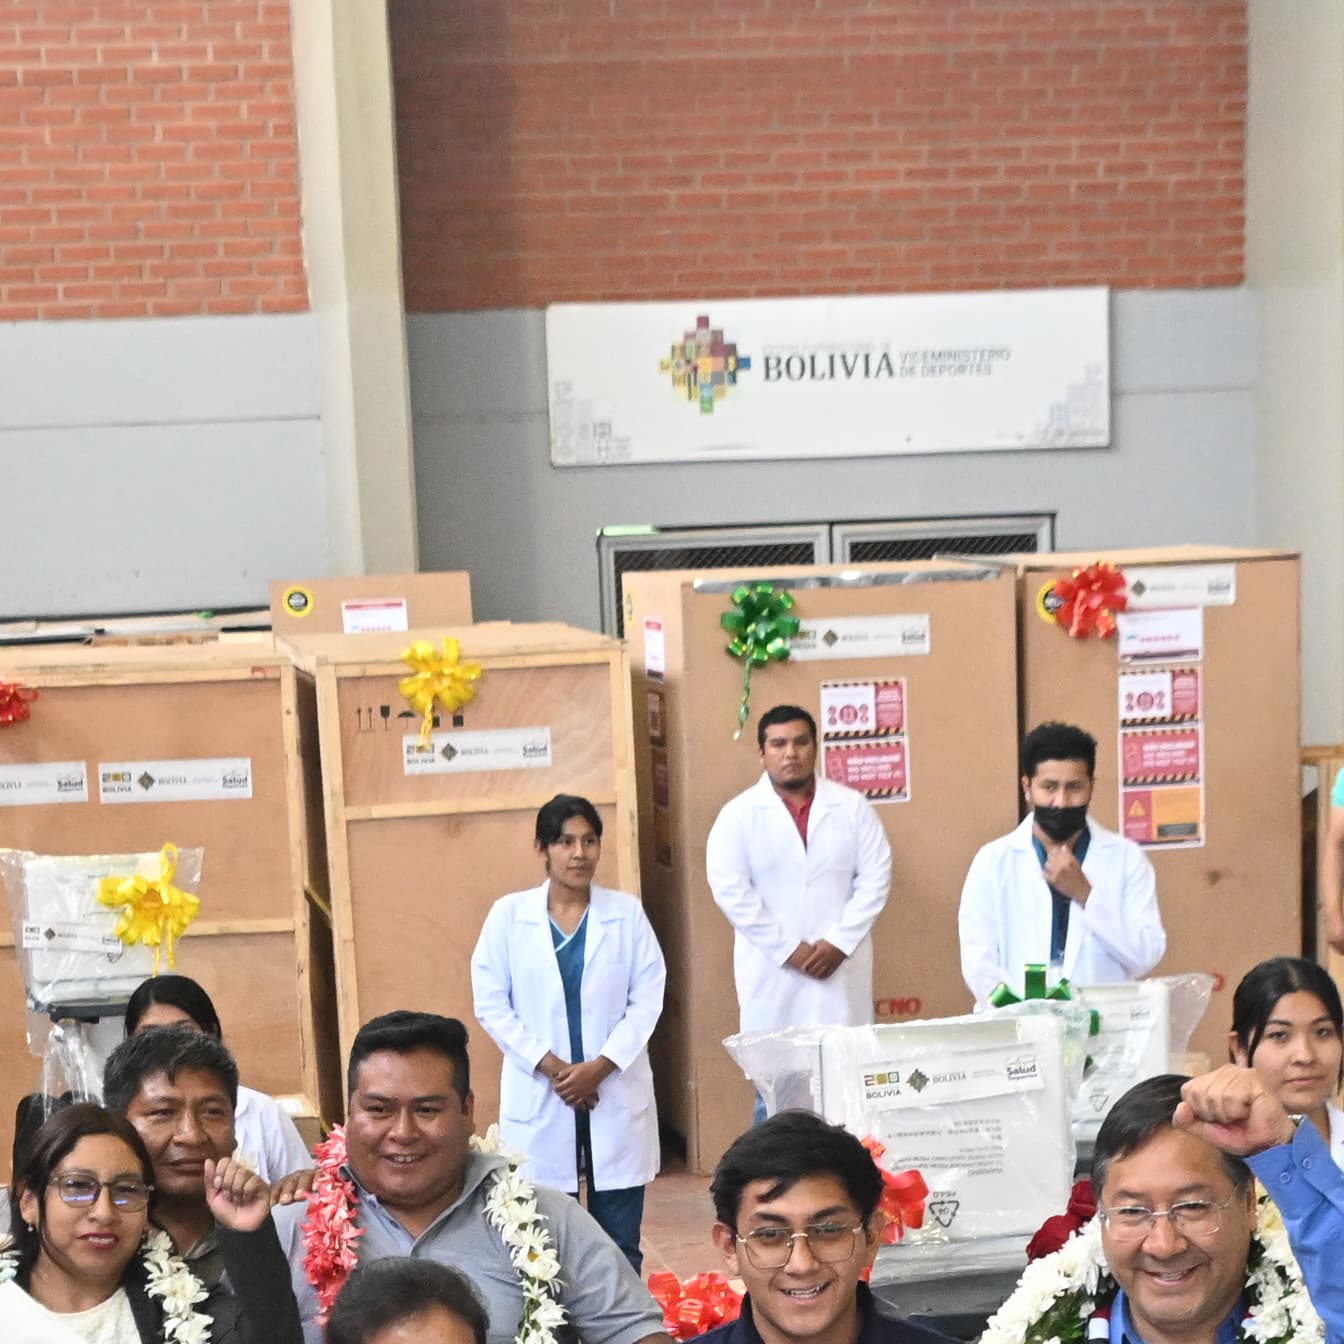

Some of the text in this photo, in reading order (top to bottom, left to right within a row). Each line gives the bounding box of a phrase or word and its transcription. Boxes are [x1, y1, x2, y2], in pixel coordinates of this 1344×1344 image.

[900, 348, 1011, 364] VICEMINISTERIO
[763, 352, 895, 382] BOLIVIA
[1007, 1064, 1037, 1076] Salud
[933, 1072, 967, 1084] BOLIVIA
[866, 1089, 902, 1100] BOLIVIA
